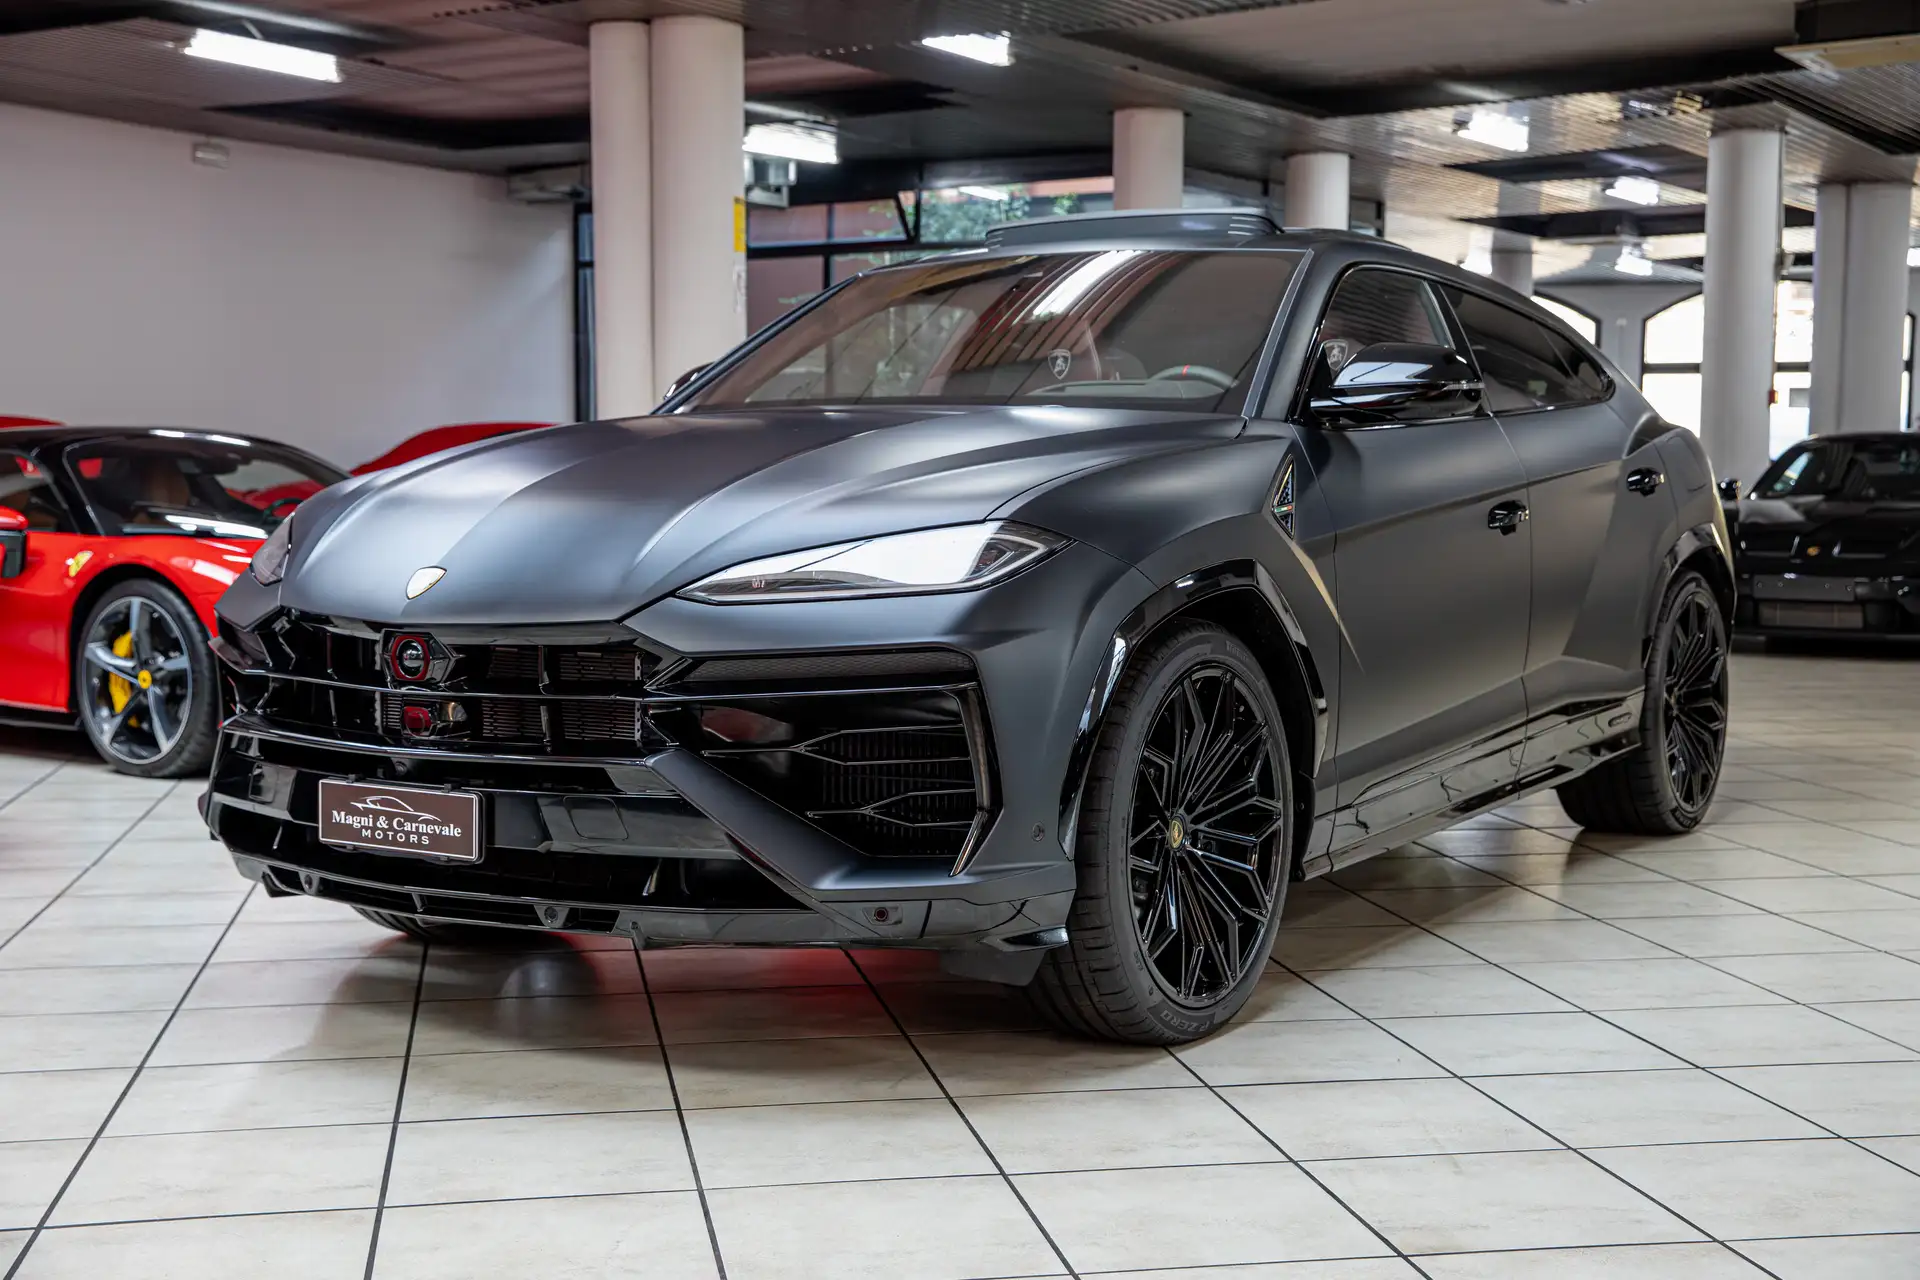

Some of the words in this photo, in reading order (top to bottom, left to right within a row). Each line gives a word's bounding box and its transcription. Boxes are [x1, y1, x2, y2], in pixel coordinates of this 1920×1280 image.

[332, 810, 373, 829] Magni
[376, 815, 389, 829] &
[393, 817, 462, 837] Carnevale
[362, 829, 430, 845] MOTORS
